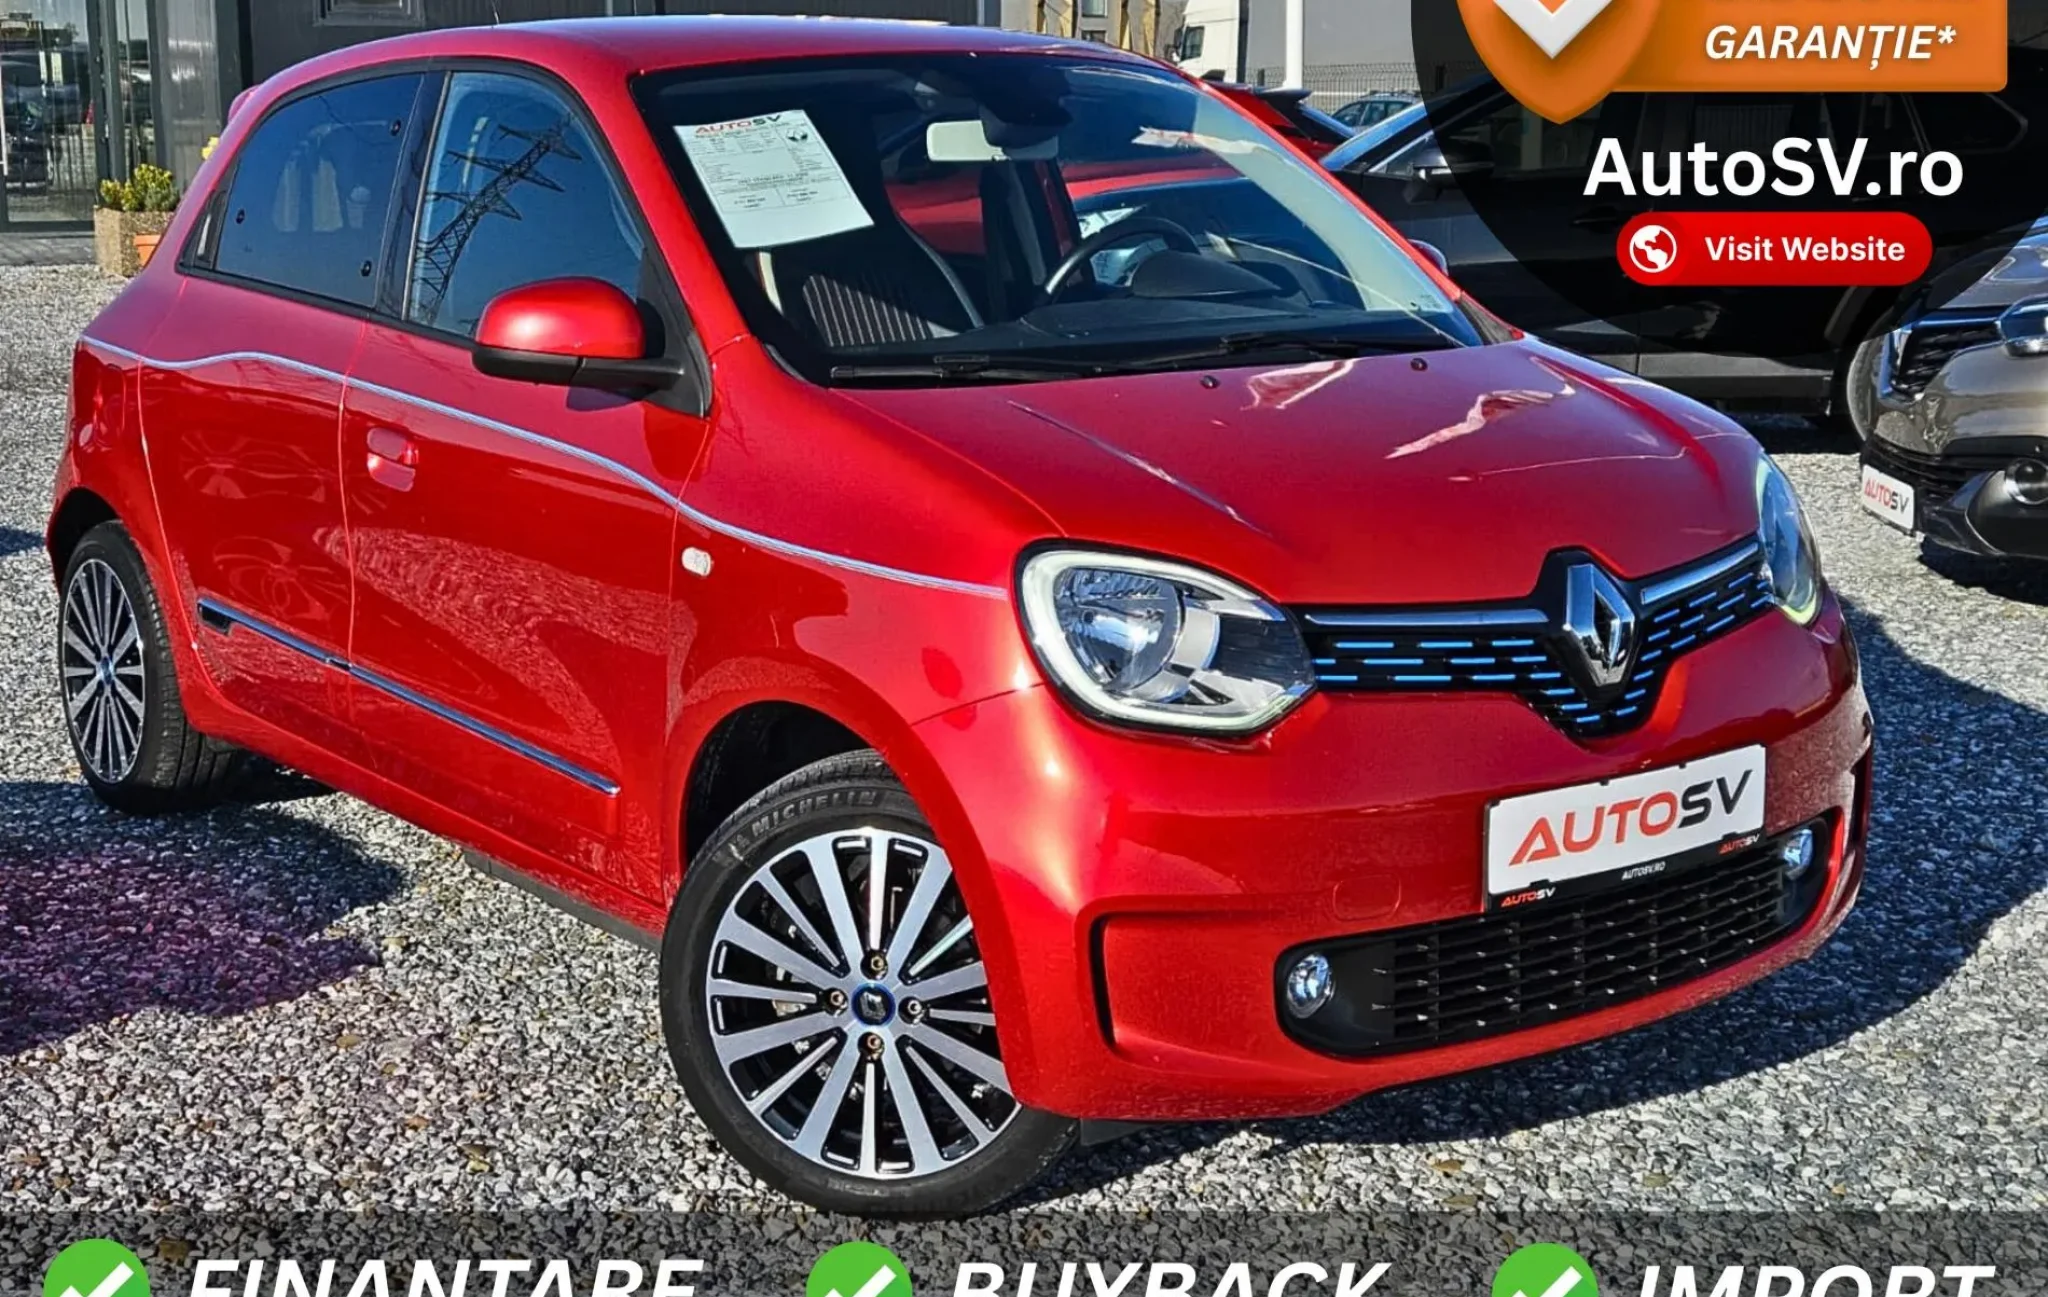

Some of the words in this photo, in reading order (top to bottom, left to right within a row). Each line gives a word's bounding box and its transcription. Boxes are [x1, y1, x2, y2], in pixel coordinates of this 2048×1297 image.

[695, 114, 781, 134] AUTOSV
[1864, 477, 1910, 515] AUTOSV
[751, 790, 877, 838] MICHELIN
[1508, 768, 1753, 867] AUTOSV
[1719, 834, 1760, 855] AUTOSV
[1500, 886, 1556, 908] AUTOSV
